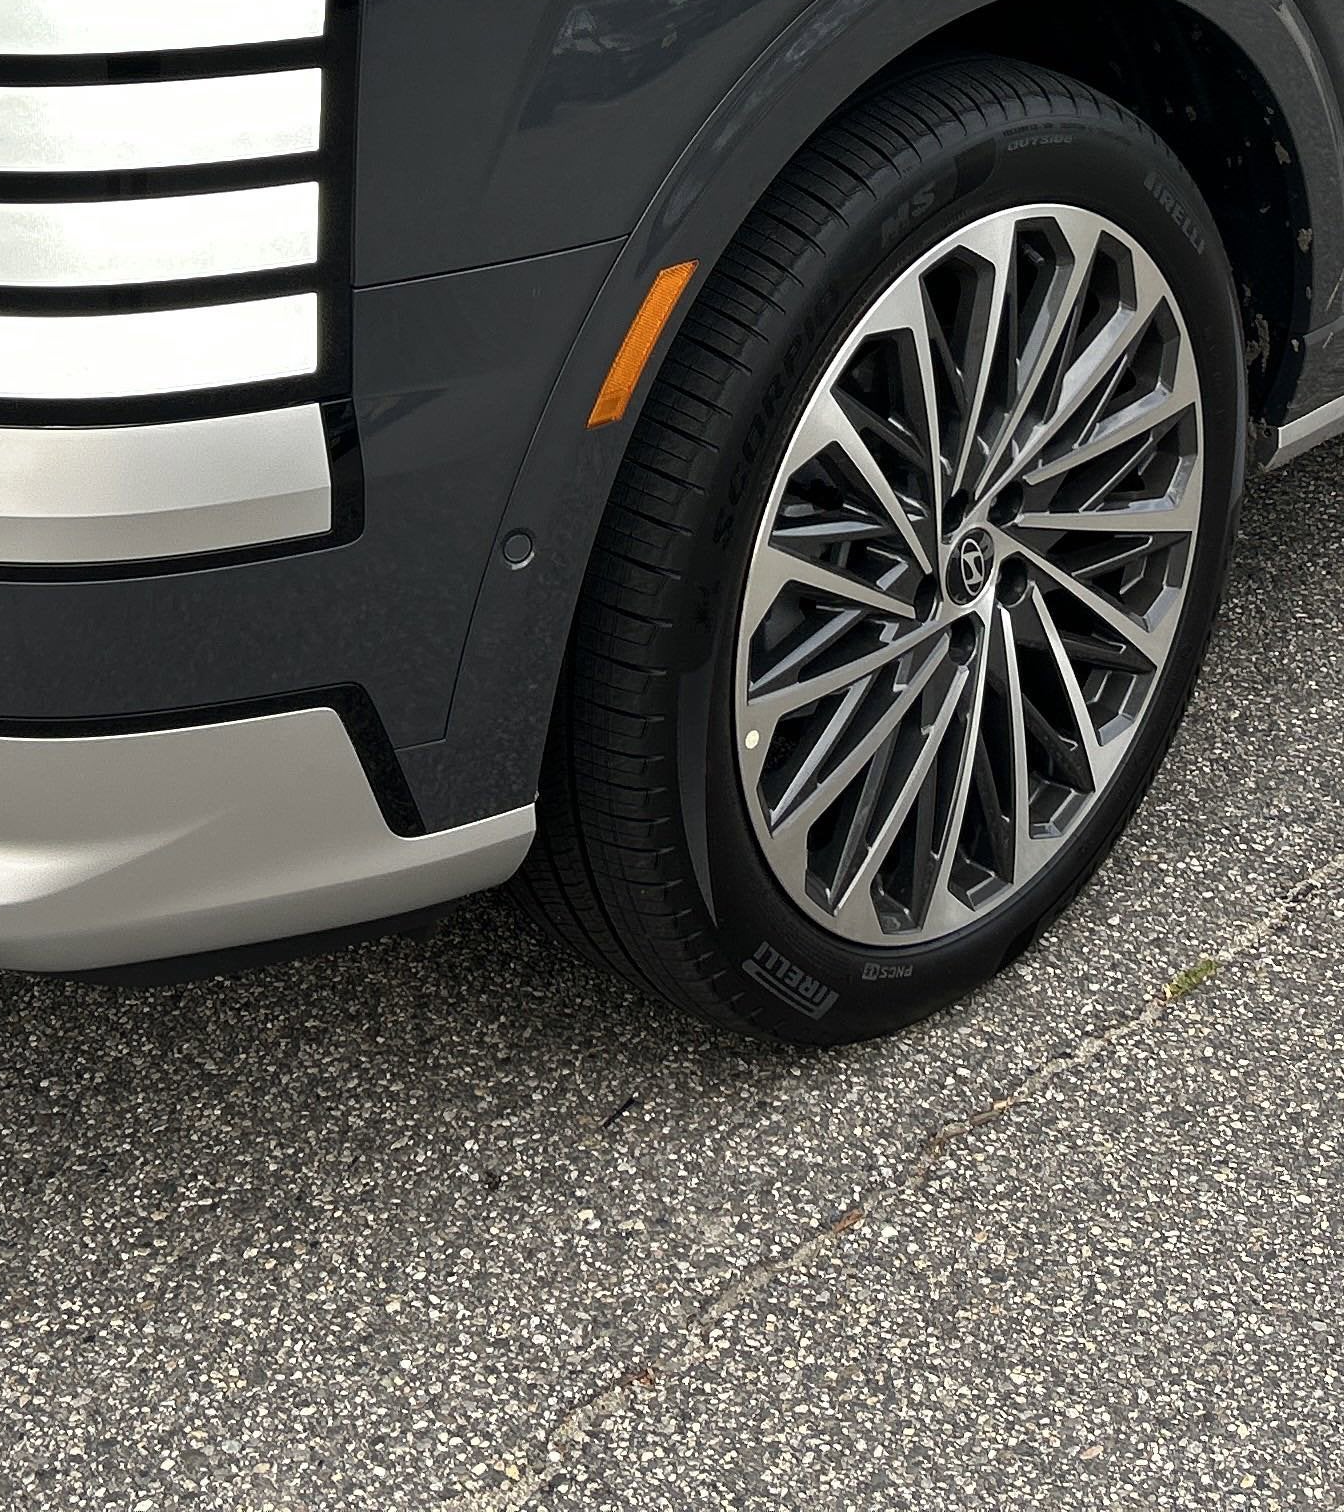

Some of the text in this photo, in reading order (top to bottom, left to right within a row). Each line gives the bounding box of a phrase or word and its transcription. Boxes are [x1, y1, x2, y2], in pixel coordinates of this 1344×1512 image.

[1144, 170, 1205, 255] PIRELLI
[743, 941, 840, 1020] PIRELLI
[879, 963, 913, 978] PNCS
